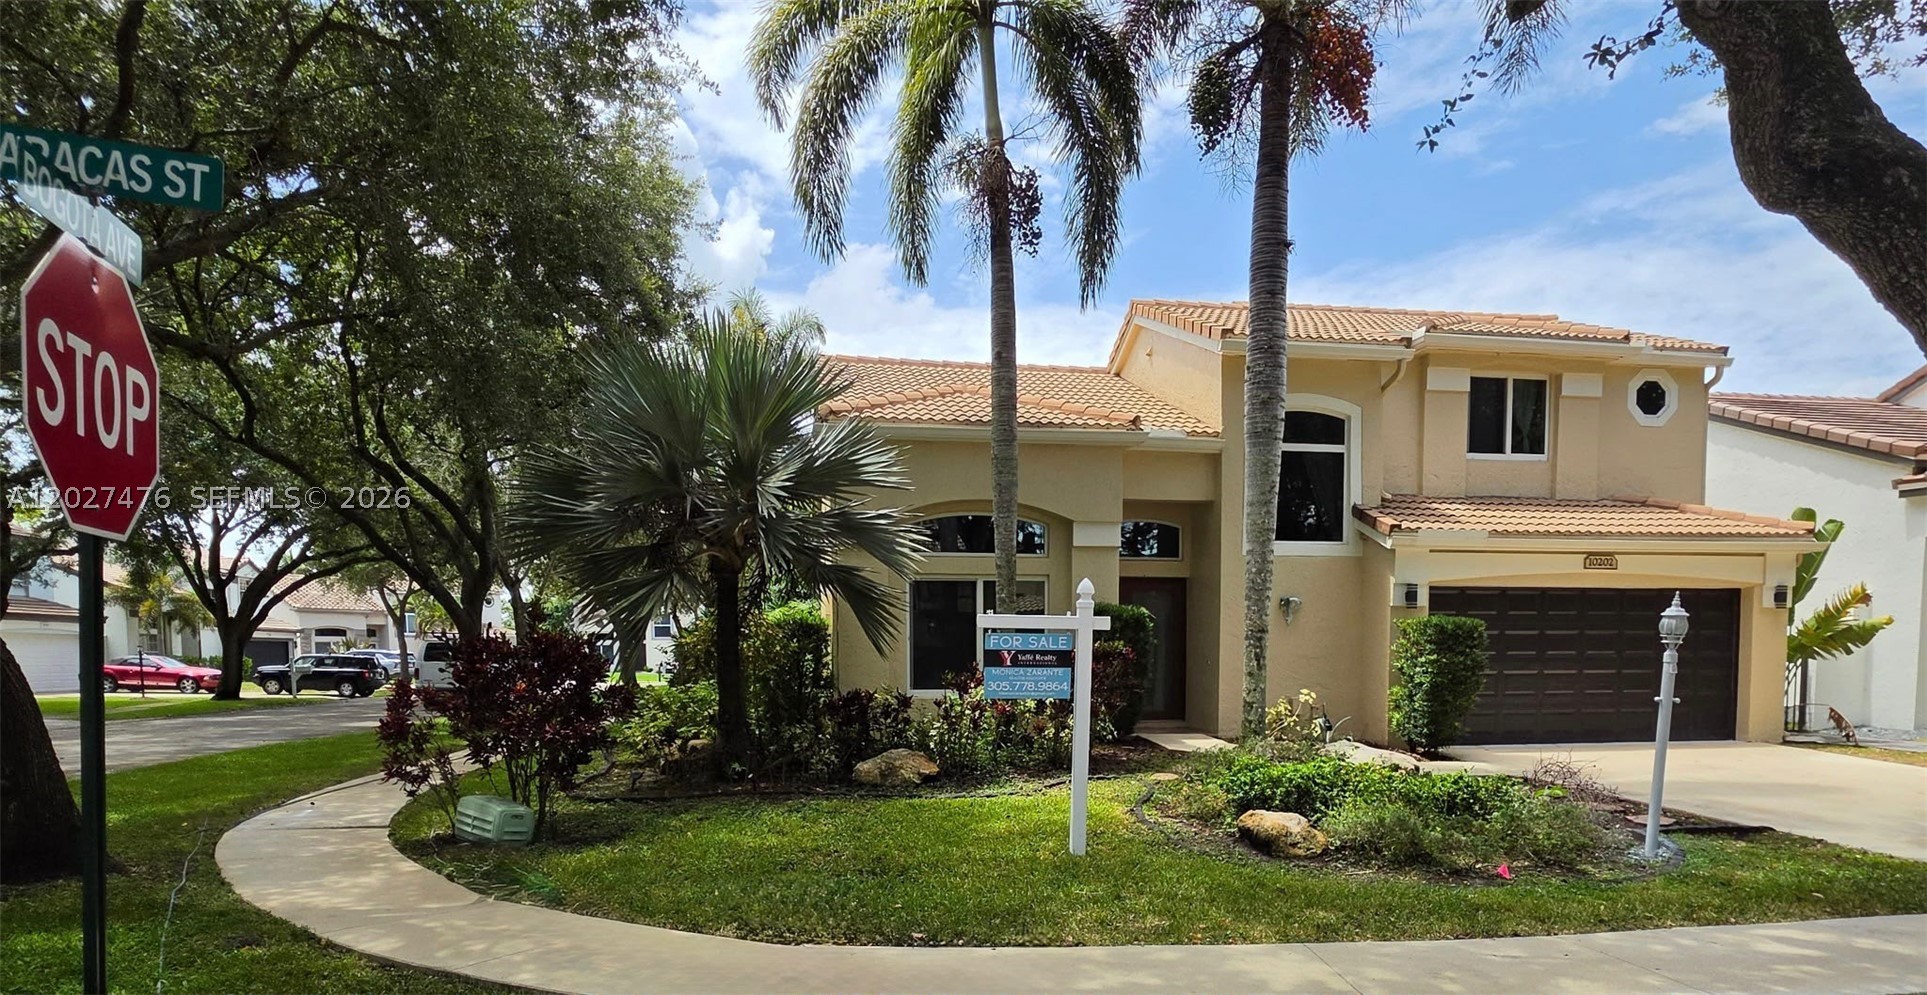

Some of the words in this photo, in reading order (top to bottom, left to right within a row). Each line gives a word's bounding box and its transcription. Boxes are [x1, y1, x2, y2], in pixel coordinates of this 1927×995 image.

[163, 158, 210, 202] ST
[24, 151, 100, 246] BOGOTA
[106, 222, 137, 277] AVE
[36, 317, 150, 456] STOP
[1588, 558, 1614, 566] 10202
[990, 636, 1022, 648] FOR
[1028, 636, 1067, 648] SALE
[1035, 653, 1057, 662] Realty
[987, 681, 1068, 691] 305.778.9864
